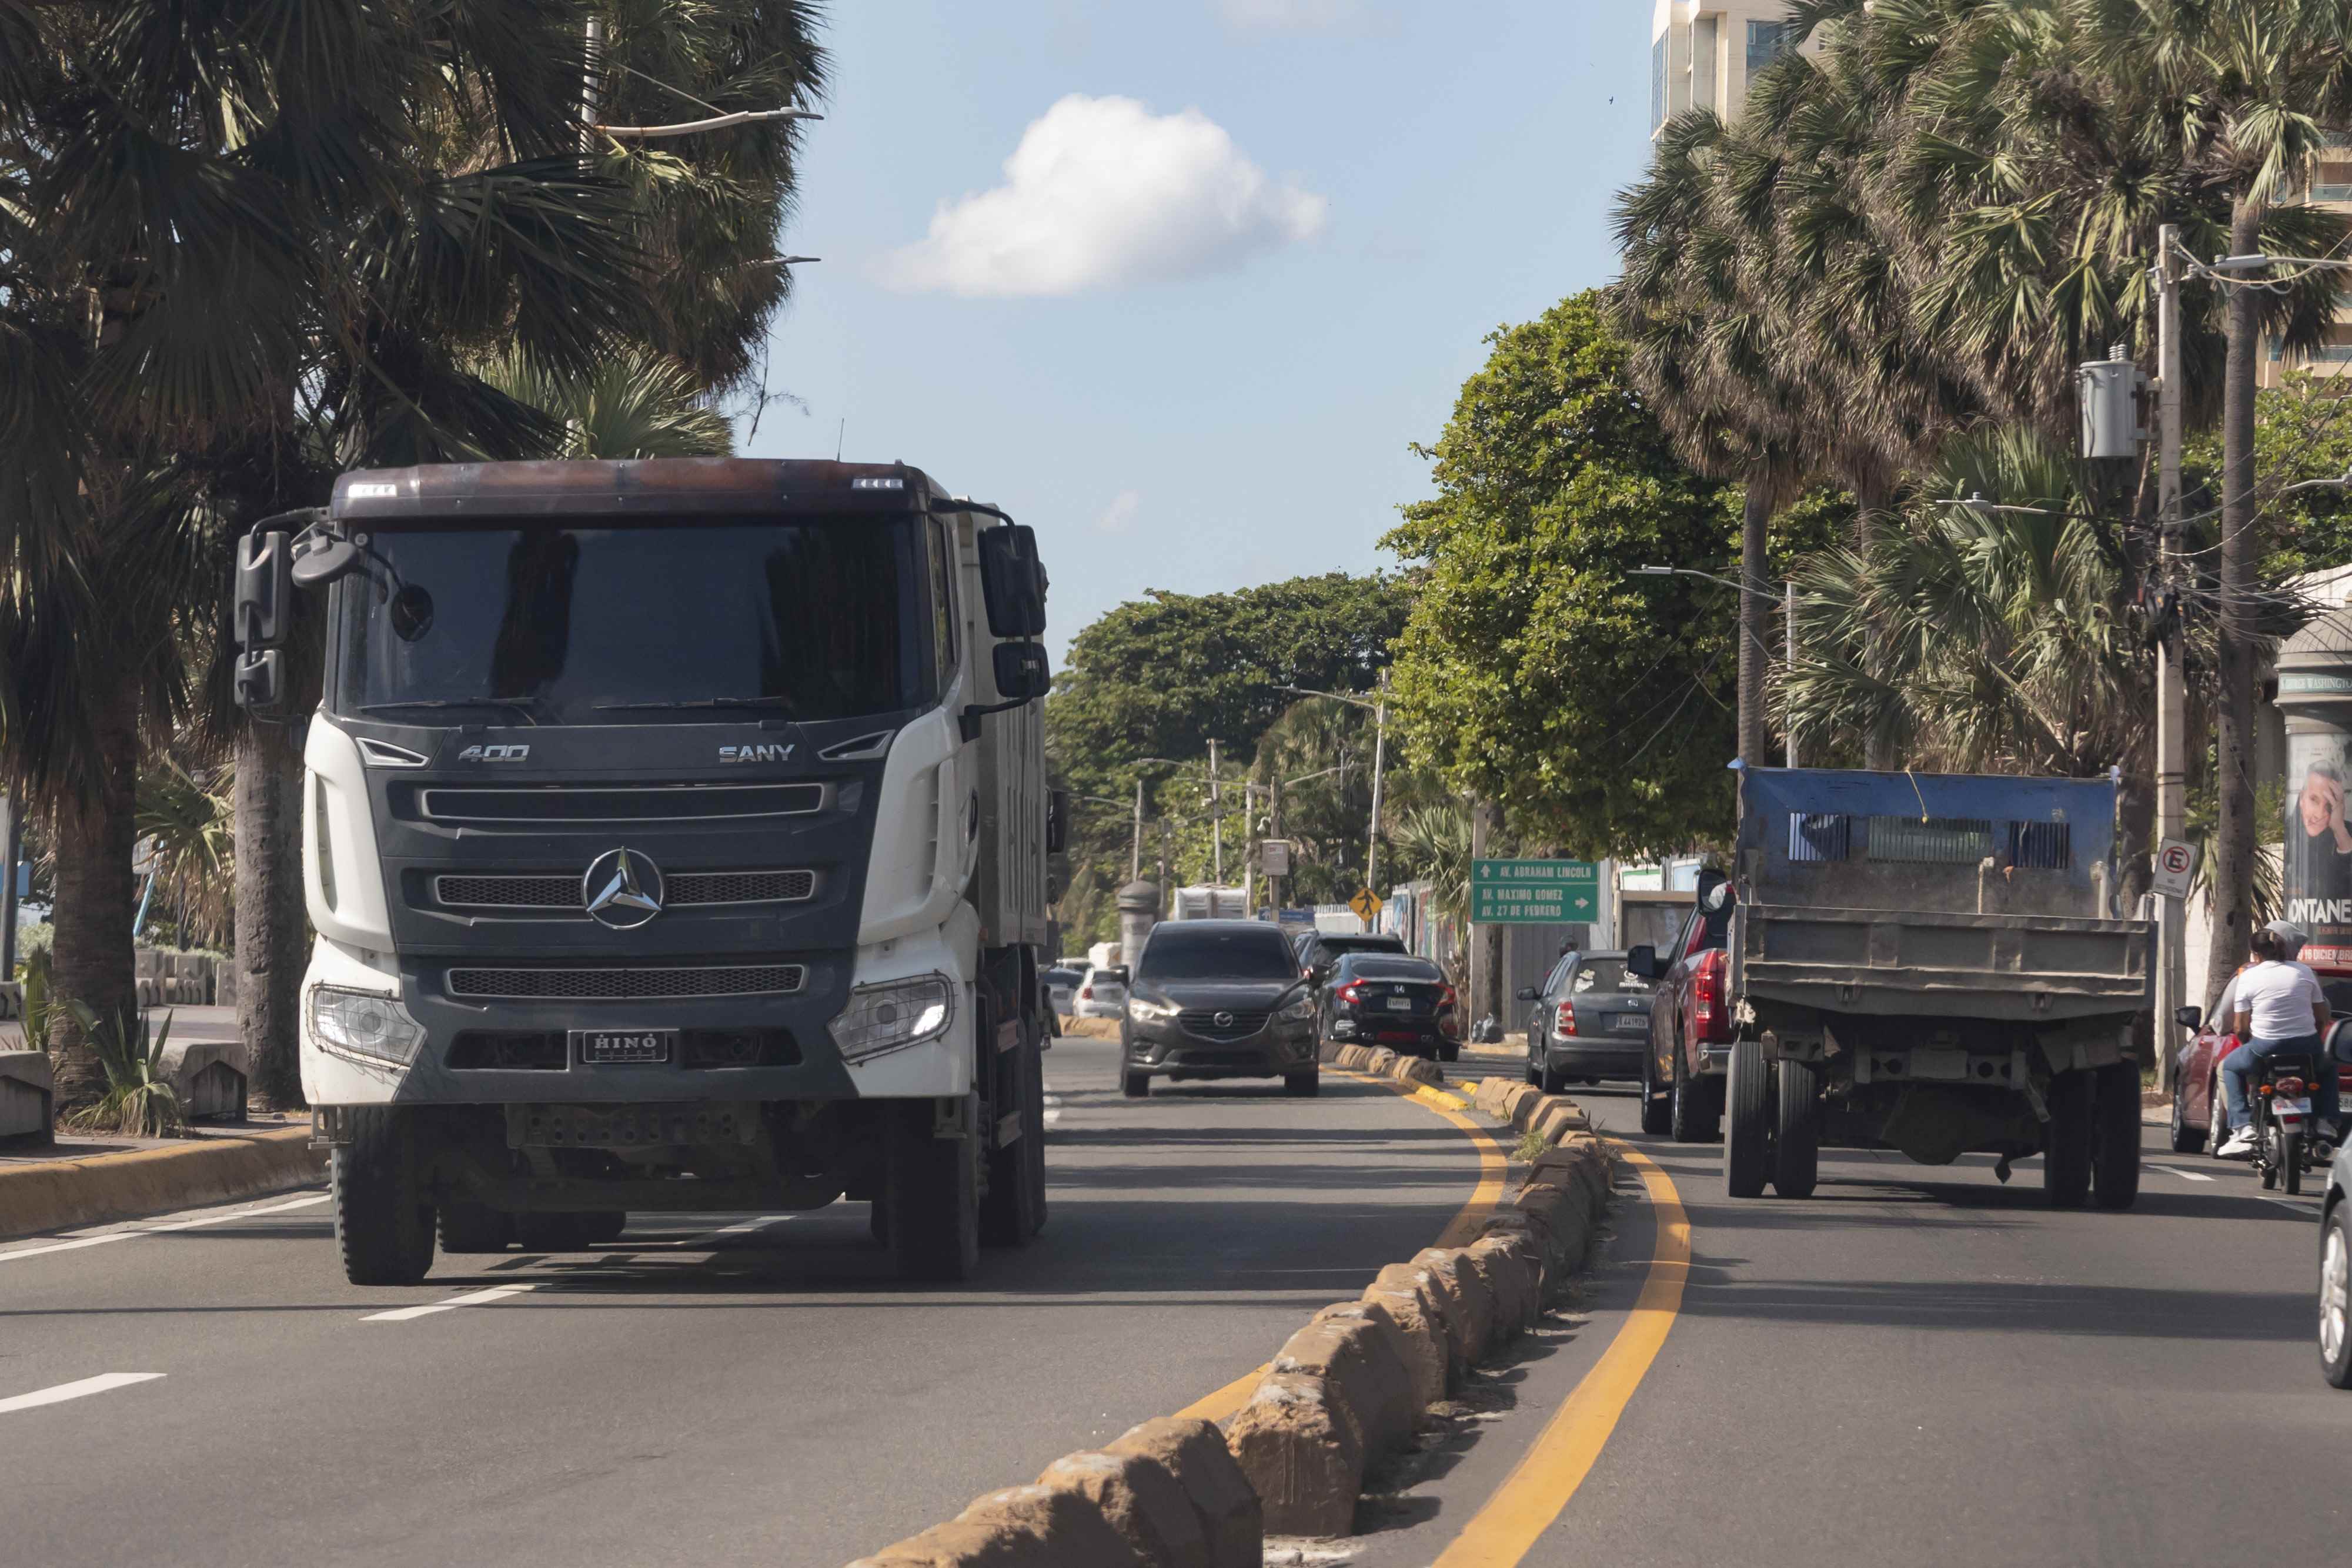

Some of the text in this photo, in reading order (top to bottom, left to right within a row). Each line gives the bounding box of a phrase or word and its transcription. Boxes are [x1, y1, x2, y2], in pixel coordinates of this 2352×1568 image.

[458, 744, 530, 762] 400
[719, 744, 796, 763] SANY
[1500, 866, 1591, 878] AV. ABRAHAM LINCOLN
[1482, 888, 1563, 901] AV. MAXIMO GOMEZ
[1481, 905, 1562, 917] AV. 27 DE FEBRERO
[2288, 898, 2352, 924] ONTANE
[594, 1037, 657, 1049] HINO
